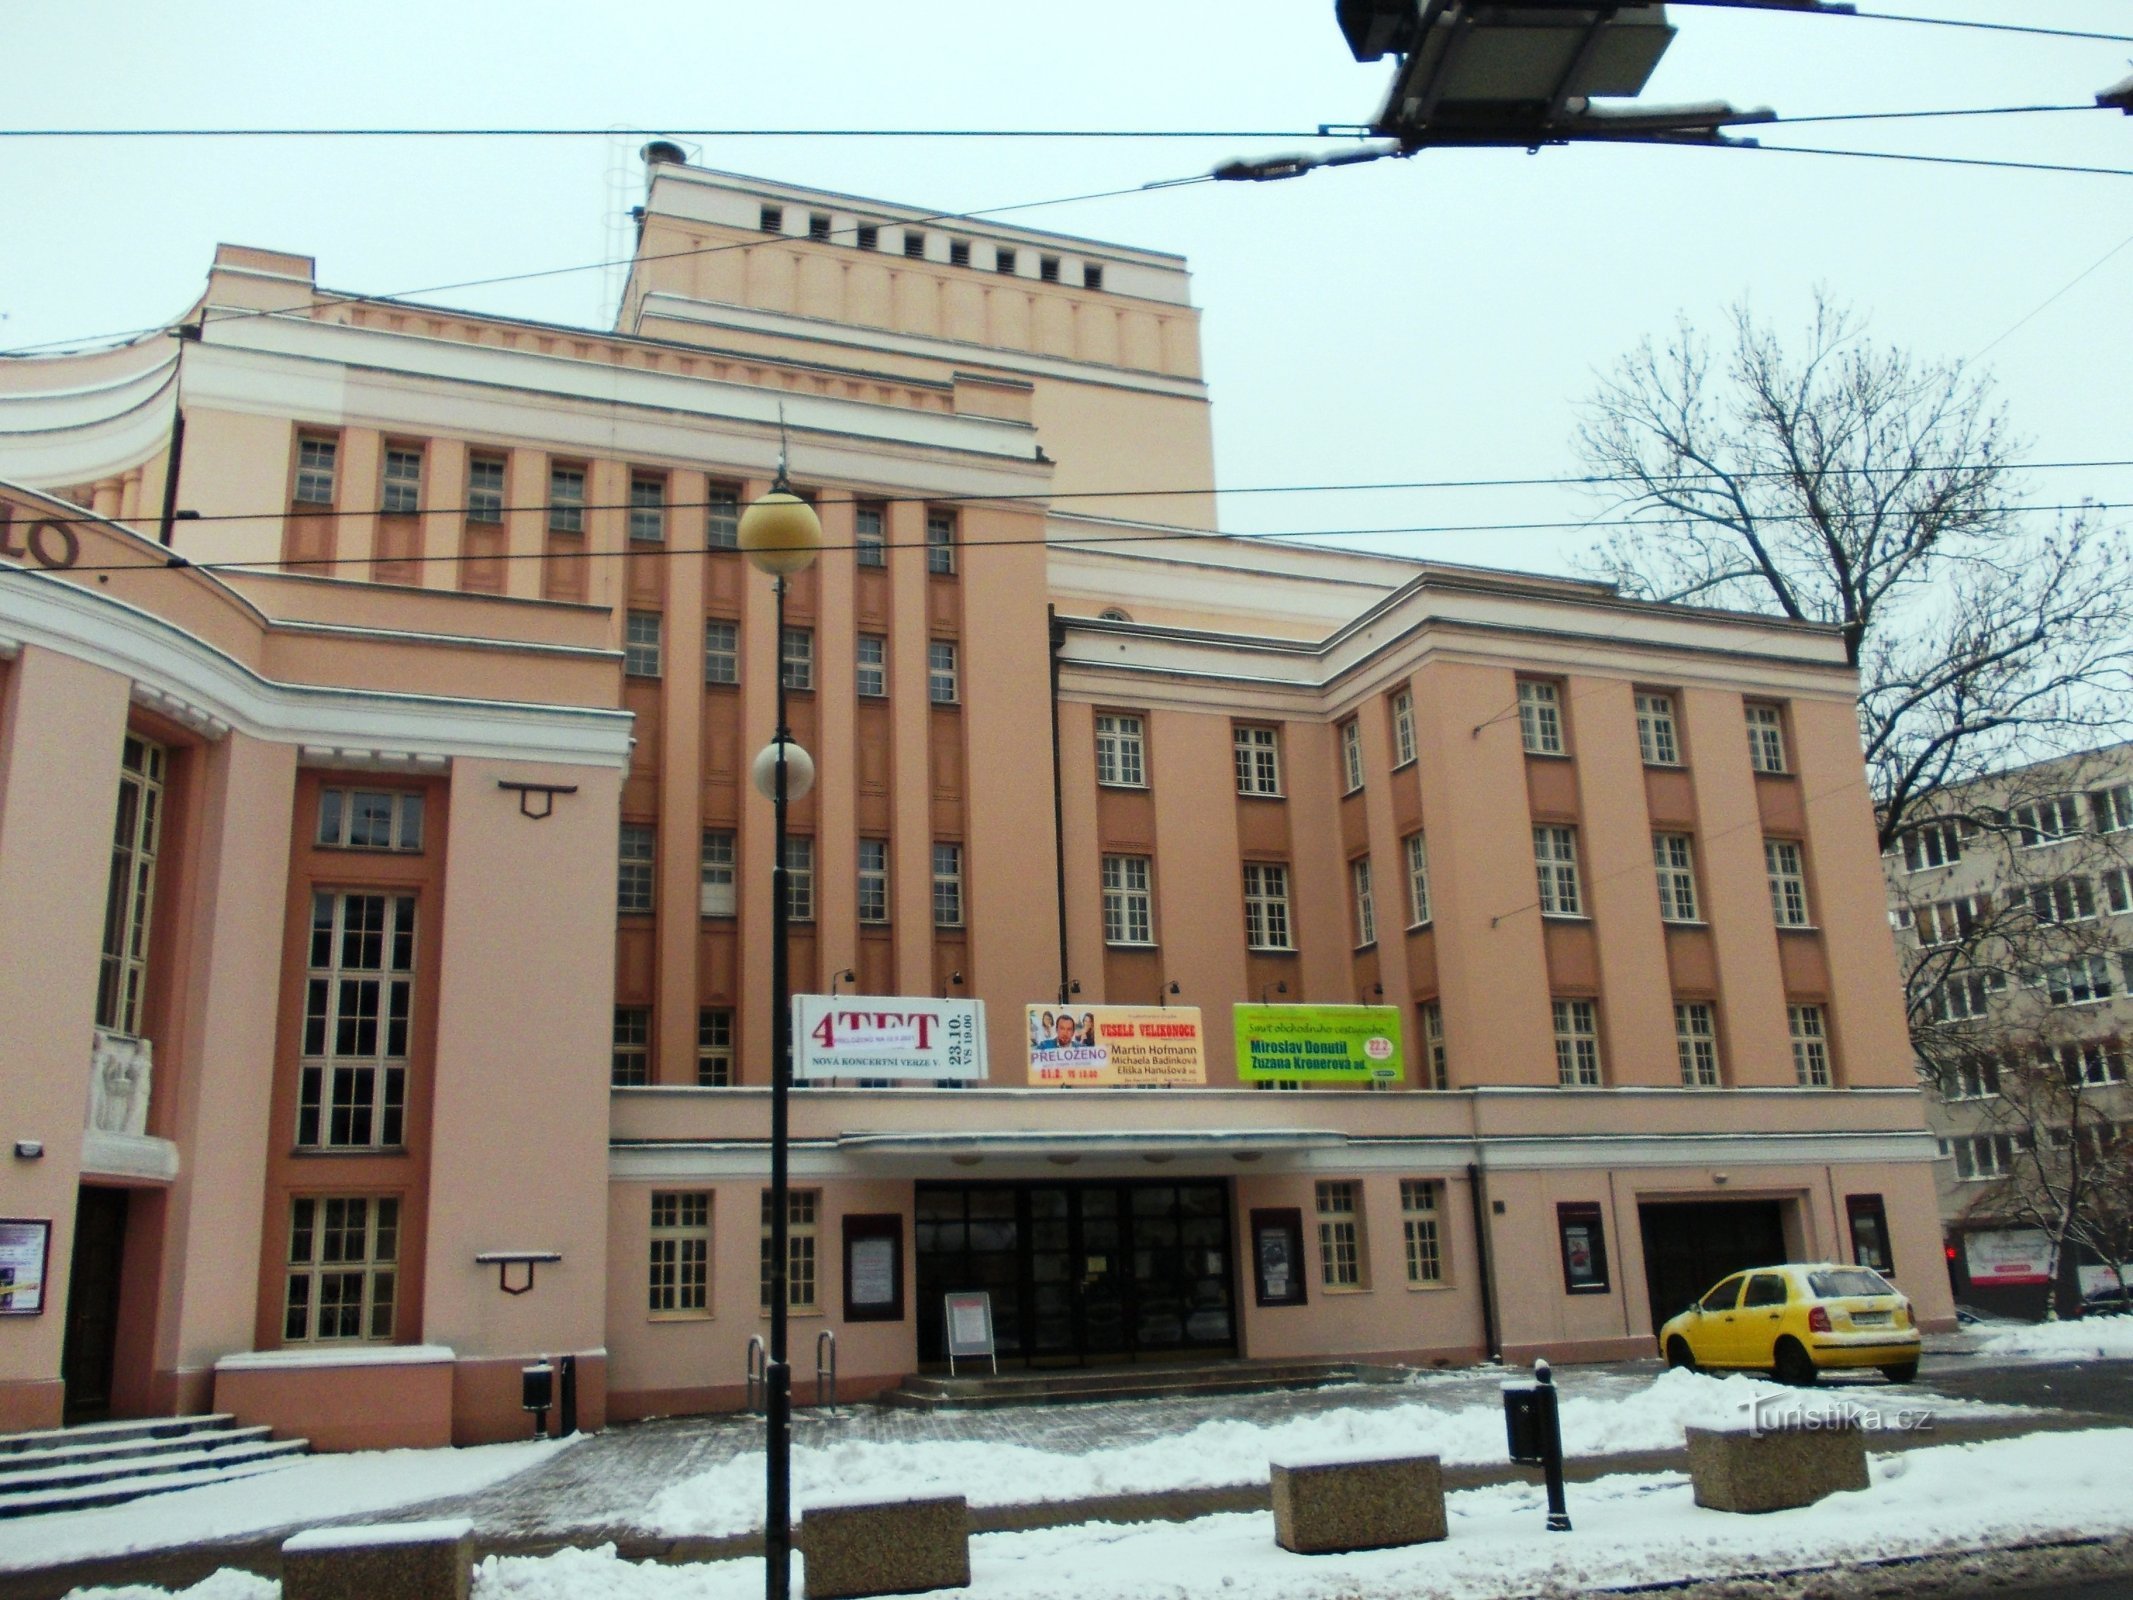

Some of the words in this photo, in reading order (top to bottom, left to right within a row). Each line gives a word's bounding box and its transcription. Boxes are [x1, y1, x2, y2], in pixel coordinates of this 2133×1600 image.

[1139, 1024, 1196, 1038] VELIKONOCE
[948, 1014, 962, 1066] 23.10.
[1111, 1044, 1146, 1055] Martin
[1149, 1044, 1197, 1055] Hofmann
[1250, 1040, 1303, 1054] Miroslav
[1305, 1040, 1348, 1055] Donutil
[900, 1058, 931, 1068] VERZE
[1111, 1056, 1151, 1065] Michaela
[1152, 1056, 1197, 1065] Badinková
[1251, 1055, 1291, 1069] Zuzana
[1117, 1066, 1143, 1075] Eliška
[1145, 1066, 1187, 1076] Hanušová
